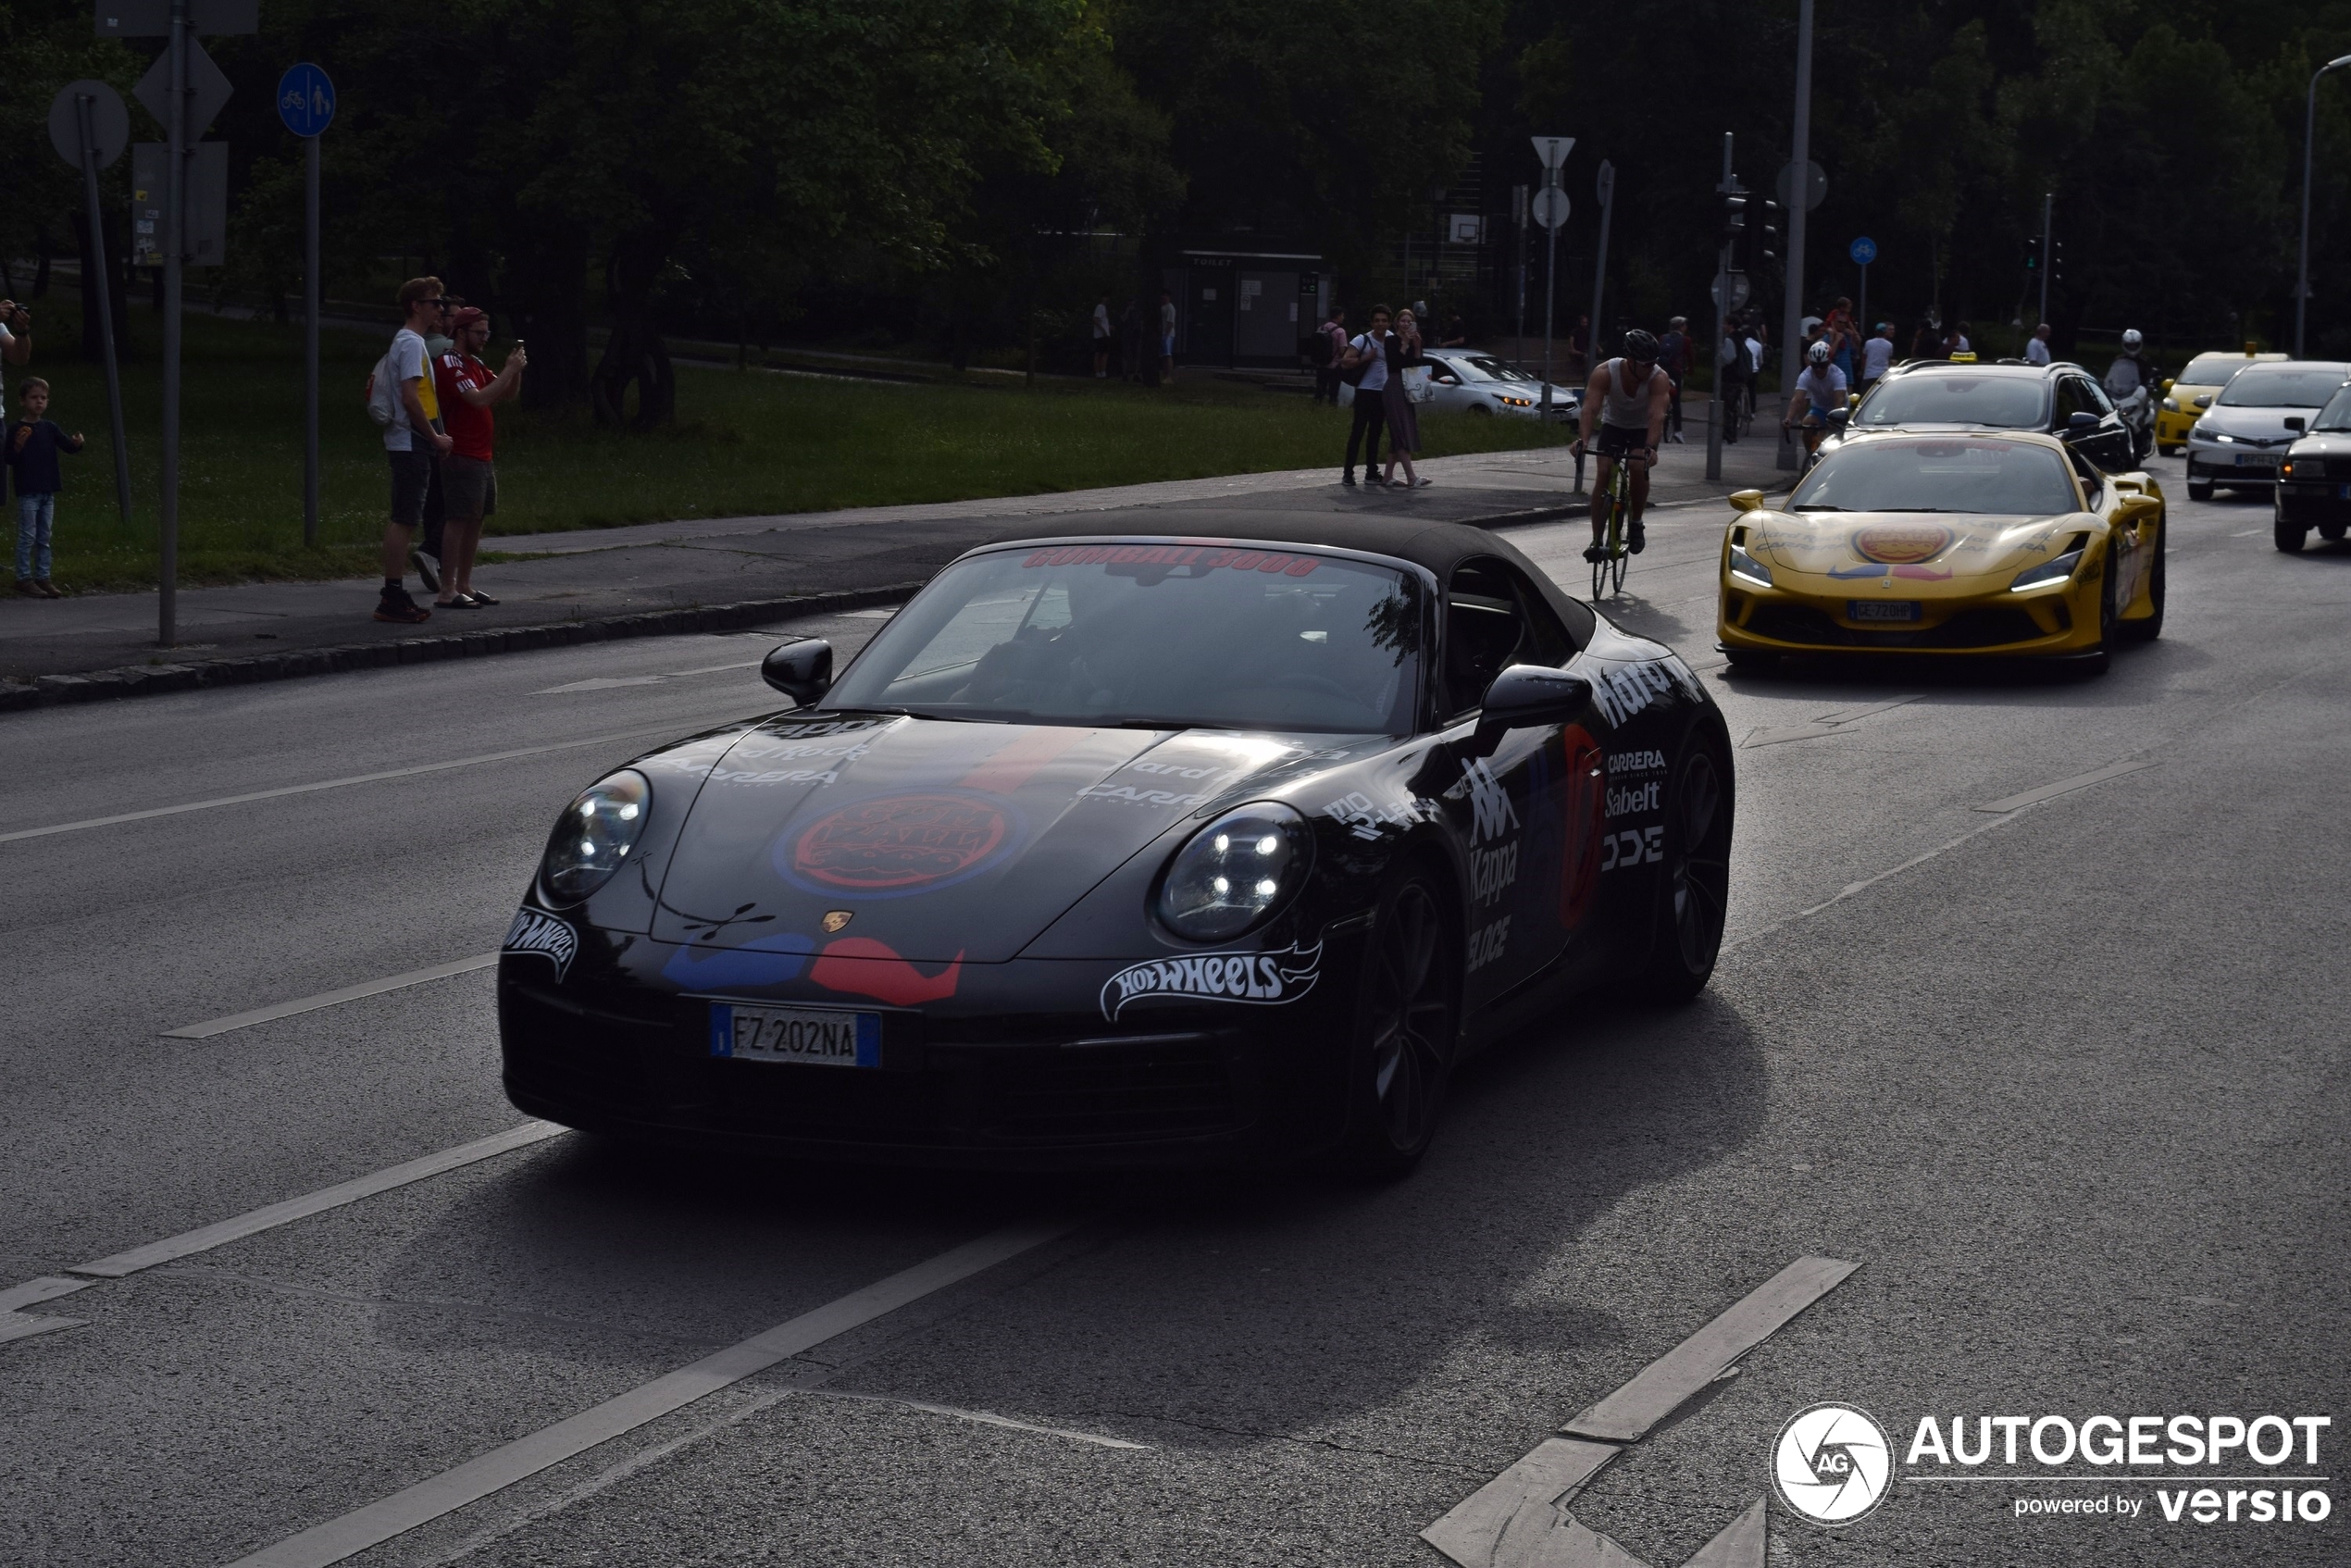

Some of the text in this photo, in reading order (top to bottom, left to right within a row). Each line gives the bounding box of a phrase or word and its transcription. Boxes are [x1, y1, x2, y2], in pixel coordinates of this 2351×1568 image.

[1194, 258, 1232, 267] TOILET
[1022, 548, 1320, 577] GUMBALL 3000
[1510, 677, 1573, 692] LONDON
[1608, 750, 1666, 774] CARRERA
[1605, 781, 1660, 818] Sabelt
[1469, 840, 1518, 907] Kappa
